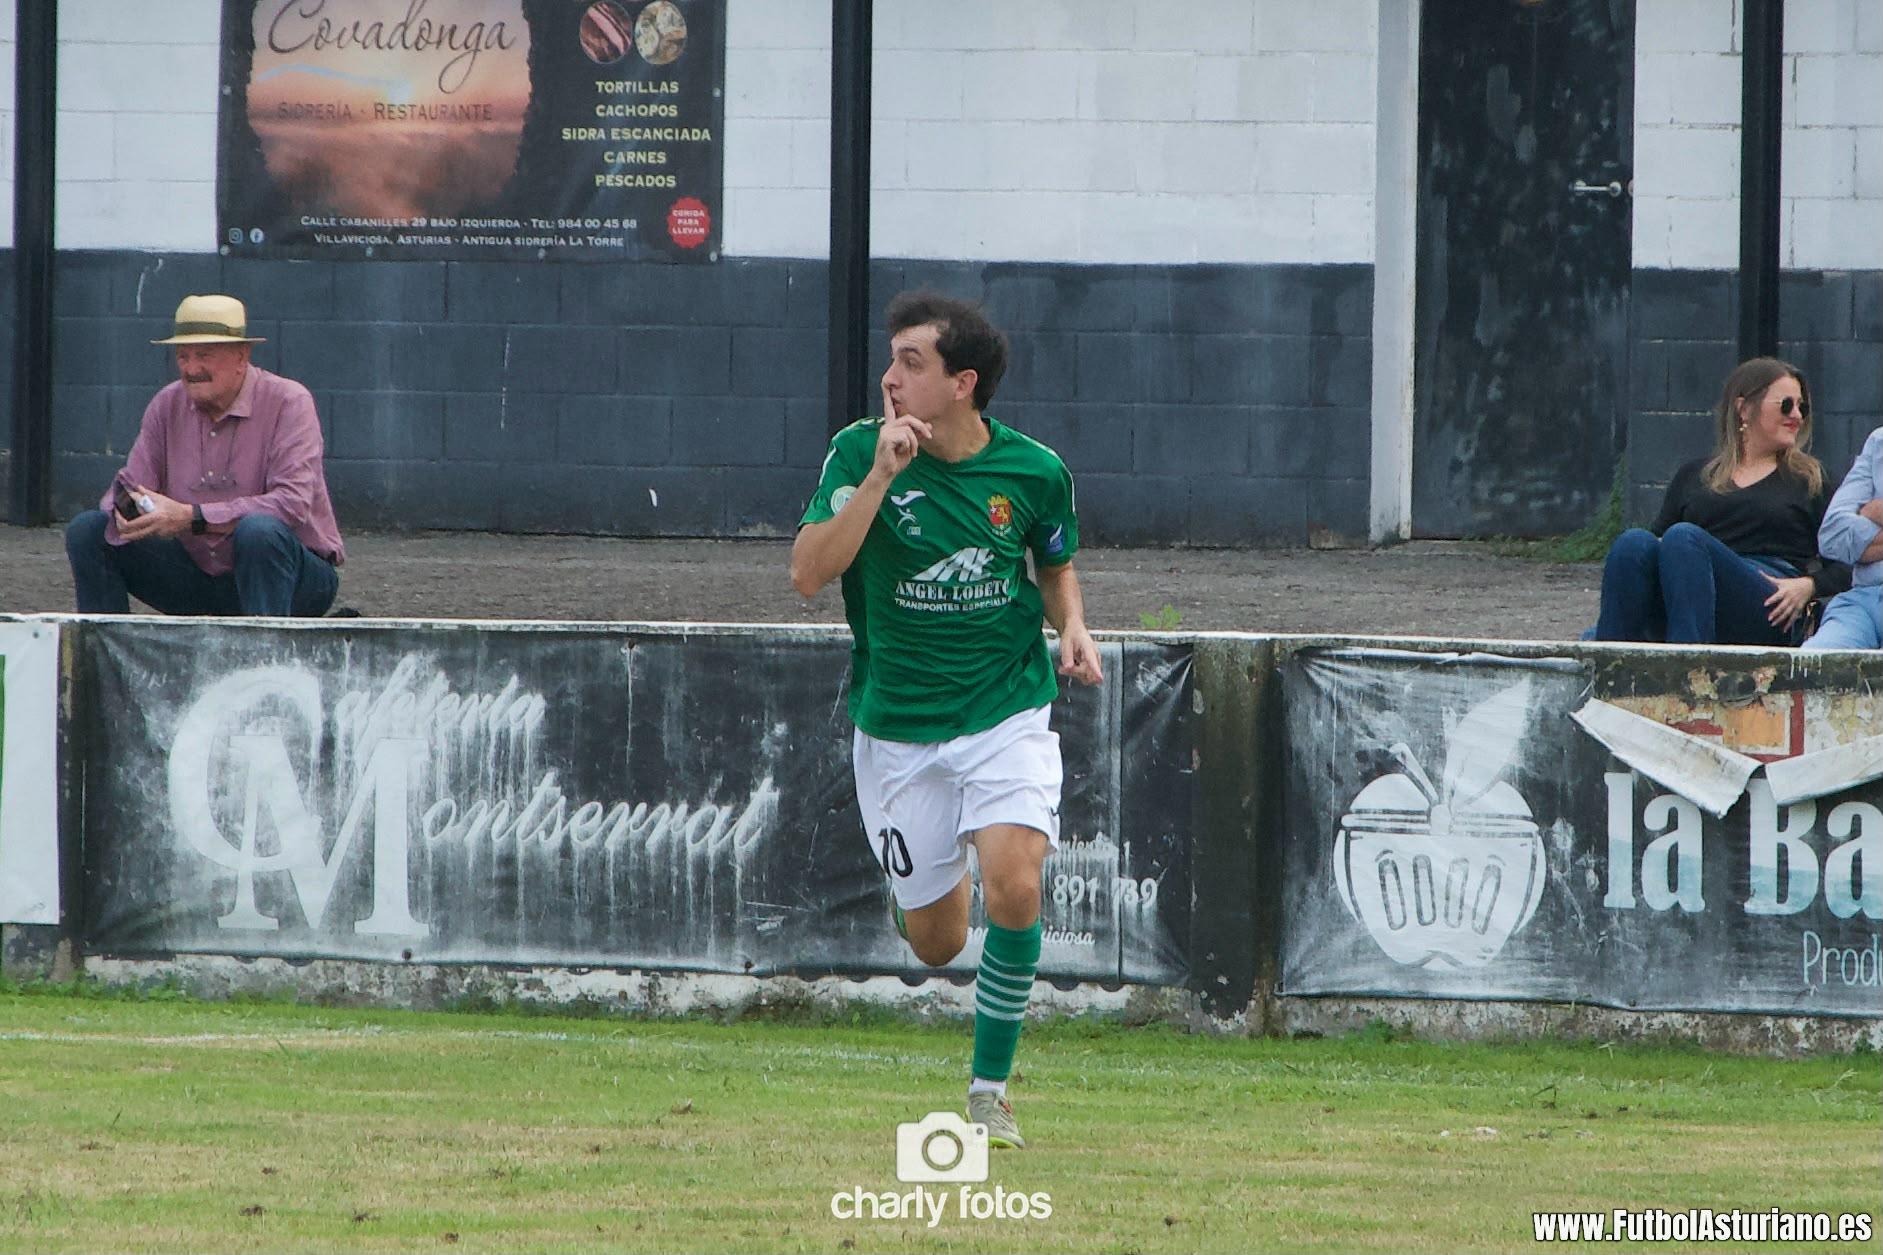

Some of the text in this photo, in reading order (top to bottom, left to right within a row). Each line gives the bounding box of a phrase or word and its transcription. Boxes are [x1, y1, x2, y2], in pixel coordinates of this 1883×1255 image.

[268, 0, 516, 94] Covadonga
[595, 81, 680, 94] TORTILLAS
[374, 102, 493, 121] RESTAURANTE
[595, 104, 679, 117] CACHOPOS
[561, 128, 712, 142] SIDRA ESCANCIADA
[603, 151, 667, 164] CARNES
[595, 175, 677, 188] PESCADOS
[300, 216, 337, 227] CALLE
[411, 217, 427, 227] 29
[430, 218, 457, 228] BAJO
[460, 218, 521, 229] IZQUIERDA
[557, 218, 582, 229] 984
[584, 218, 601, 229] 00
[603, 218, 620, 229] 45
[396, 234, 451, 245] ASTURIAS
[462, 235, 512, 246] ANTIGUA
[569, 235, 584, 246] LA
[587, 235, 625, 247] TORRE
[895, 580, 947, 601] ANGEL
[1603, 766, 1706, 913] la
[878, 827, 914, 879] 10
[1052, 873, 1099, 908] 891
